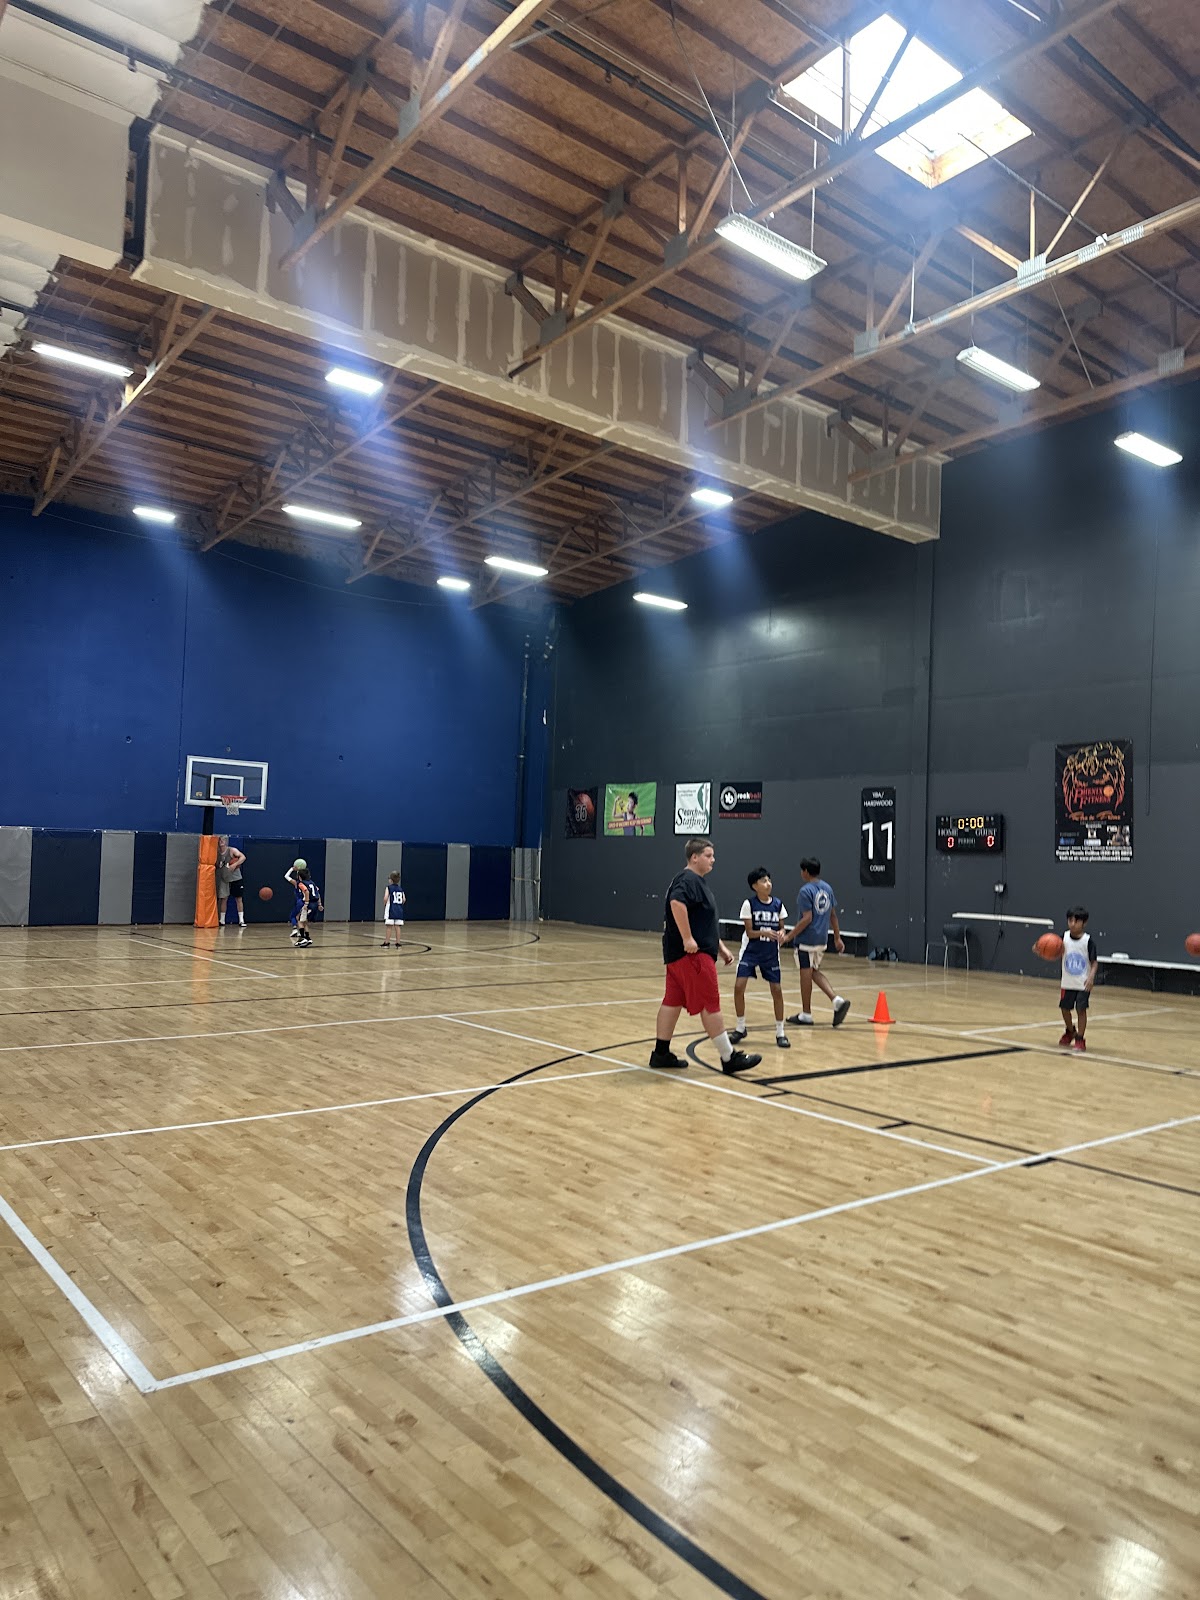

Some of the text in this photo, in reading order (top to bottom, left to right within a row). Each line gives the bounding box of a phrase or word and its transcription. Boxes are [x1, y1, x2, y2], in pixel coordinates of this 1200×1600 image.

[863, 799, 893, 807] HARDWOOD
[958, 817, 984, 830] 0:00
[938, 828, 997, 837] HOME GUEST
[862, 821, 893, 860] 11
[947, 837, 955, 848] 0
[987, 836, 995, 847] 0
[869, 864, 886, 872] COURT
[392, 891, 403, 904] 18
[753, 911, 780, 922] YBA
